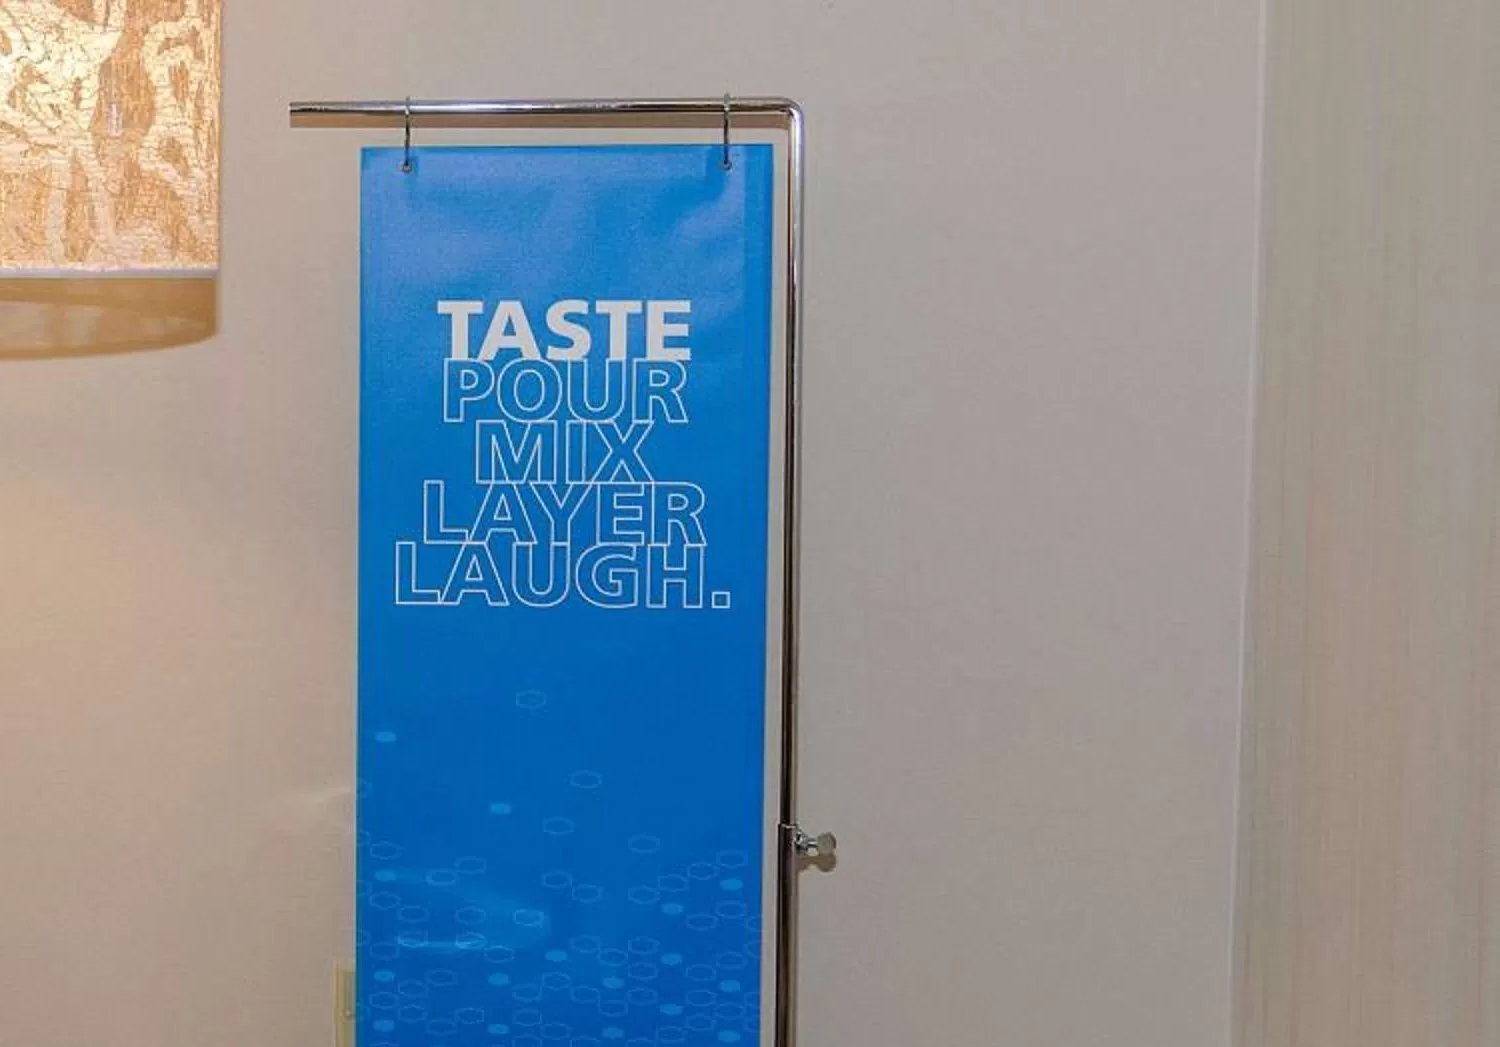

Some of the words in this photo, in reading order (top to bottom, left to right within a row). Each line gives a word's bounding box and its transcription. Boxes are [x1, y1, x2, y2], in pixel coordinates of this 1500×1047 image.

[437, 299, 692, 361] TASTE
[443, 358, 689, 423] POUR
[475, 419, 655, 484] MIX
[423, 480, 707, 546] LAYER
[395, 541, 731, 609] LAUGH.
